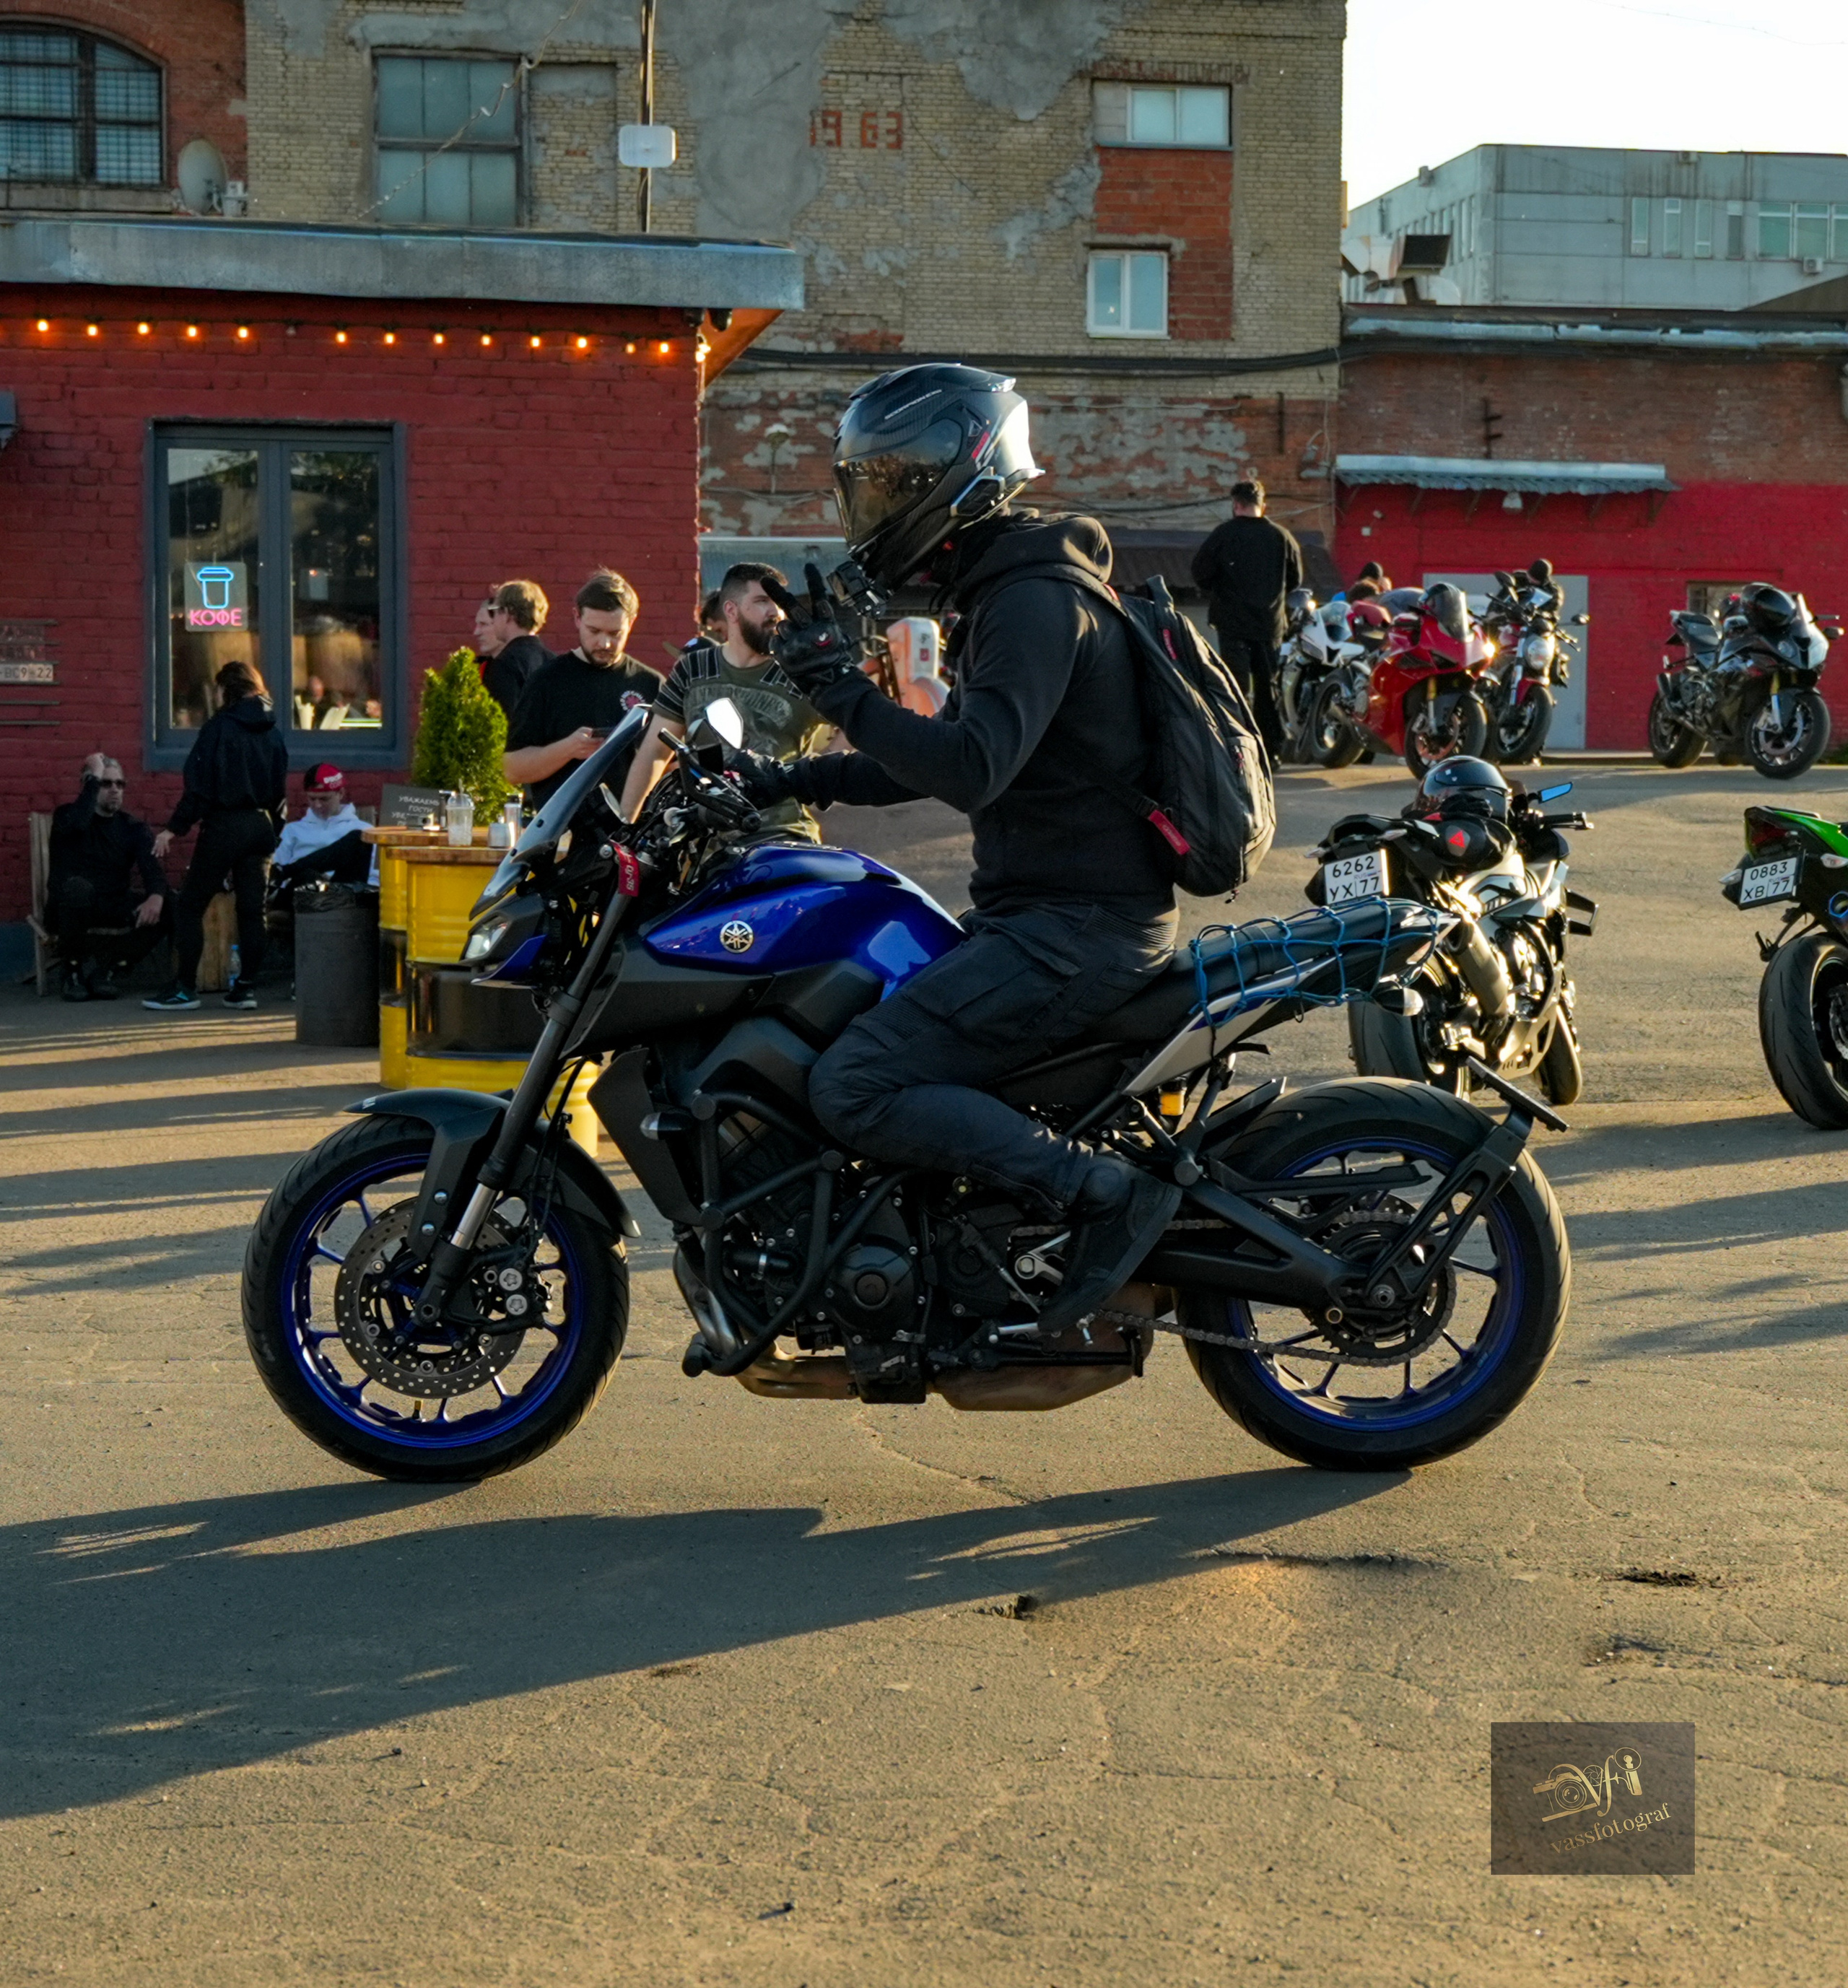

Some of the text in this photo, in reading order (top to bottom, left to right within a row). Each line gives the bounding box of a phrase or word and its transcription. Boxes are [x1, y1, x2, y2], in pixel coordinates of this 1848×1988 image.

[190, 607, 243, 627] КОФЕ
[1333, 855, 1374, 878] 6262
[1751, 861, 1788, 881] 0883
[1359, 876, 1380, 894] 77
[1772, 880, 1790, 894] 77
